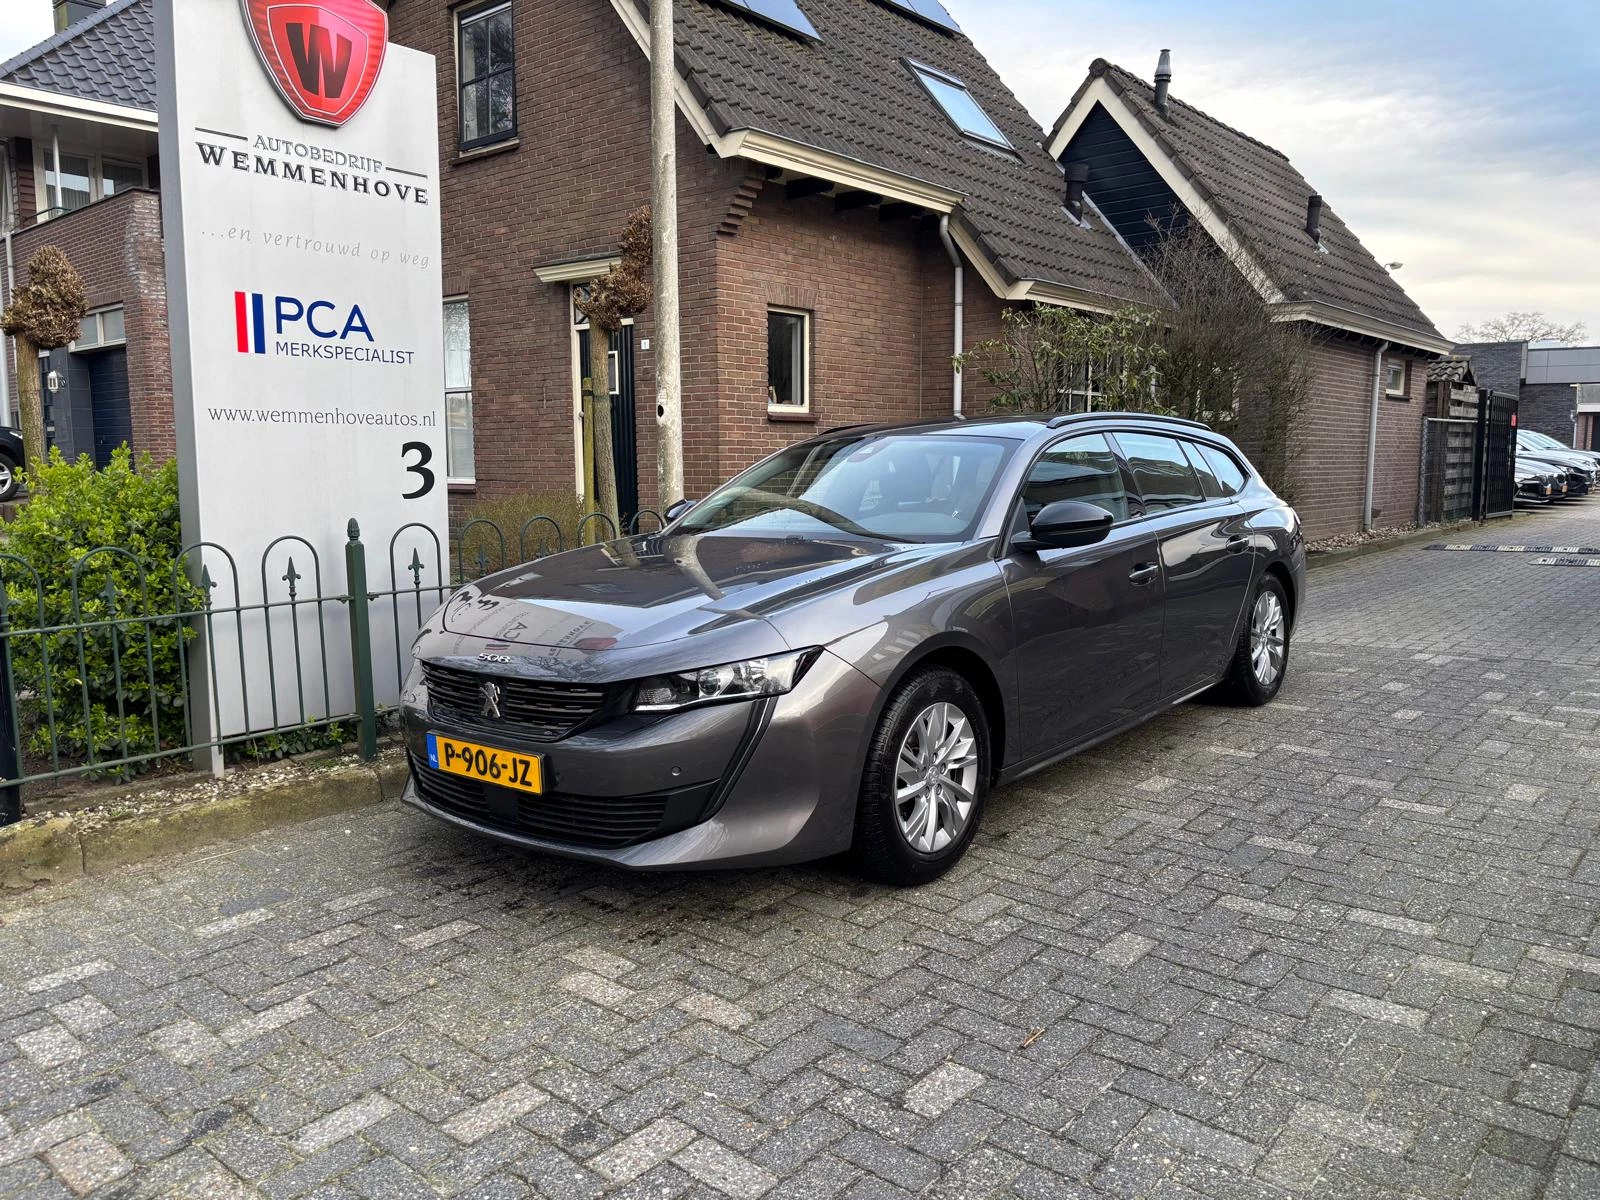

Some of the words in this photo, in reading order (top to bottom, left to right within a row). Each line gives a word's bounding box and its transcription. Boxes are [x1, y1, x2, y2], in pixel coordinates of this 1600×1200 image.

[285, 22, 353, 99] W
[195, 141, 429, 206] WEMMENHOVE
[253, 134, 384, 174] AUTOBEDRIJF
[263, 230, 361, 258] vertrouwd
[370, 247, 390, 264] op
[399, 251, 430, 270] weg
[275, 295, 375, 343] PCA
[275, 341, 415, 365] MERKSPECIALIST
[207, 407, 436, 427] www.wemmenhoveautos.nl
[400, 441, 435, 500] 3
[477, 652, 511, 664] 508
[444, 742, 533, 787] P-906-JZ
